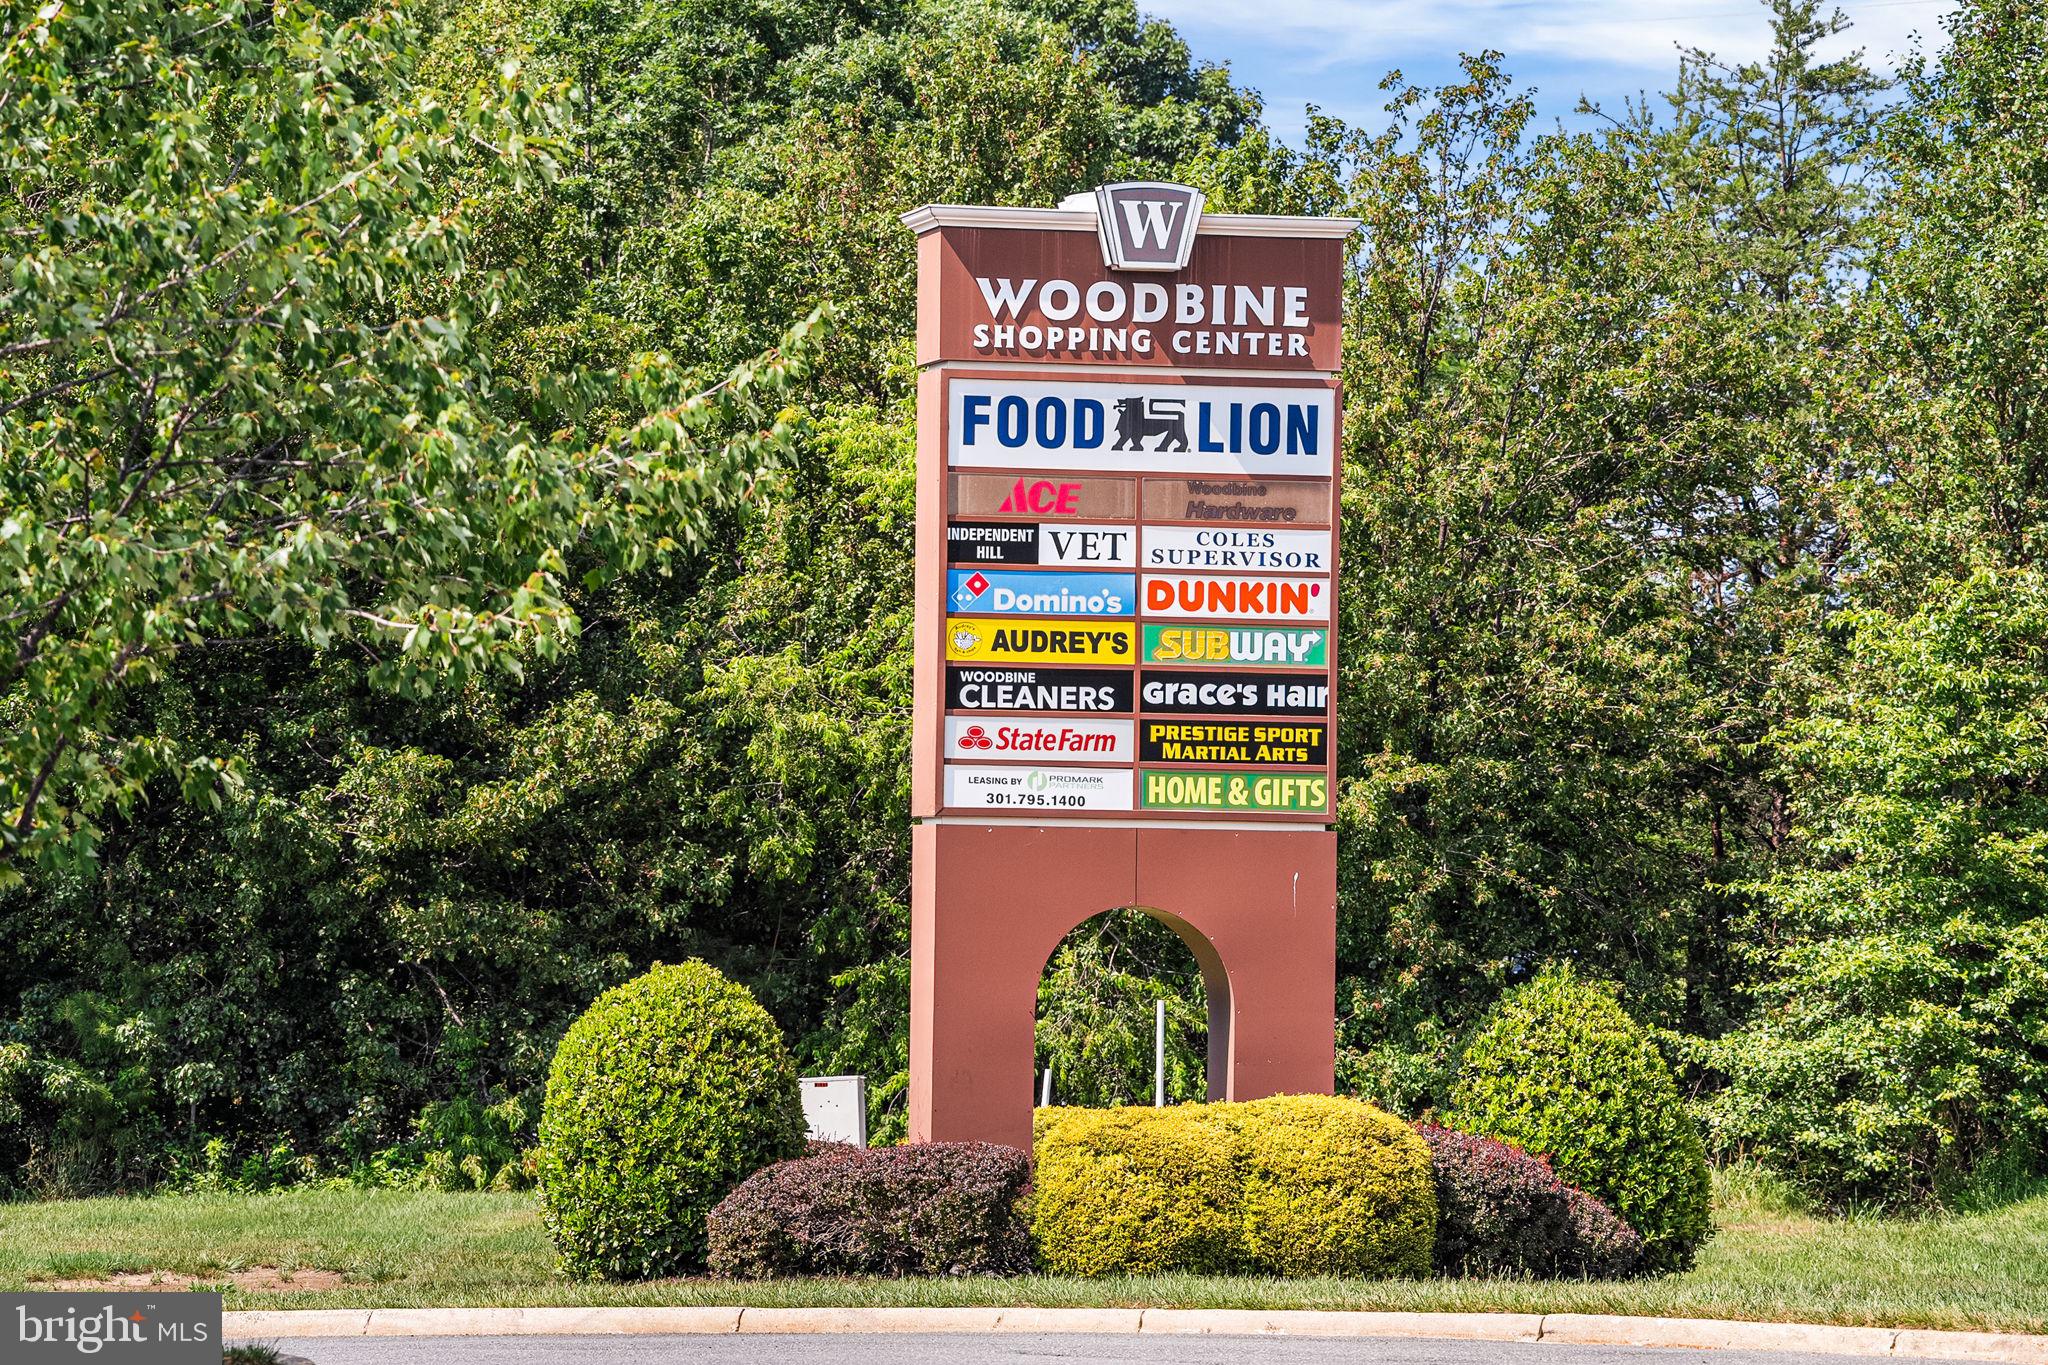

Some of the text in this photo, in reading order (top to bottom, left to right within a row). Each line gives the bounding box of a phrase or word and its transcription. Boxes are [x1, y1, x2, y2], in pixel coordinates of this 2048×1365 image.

[1119, 200, 1183, 250] W
[976, 277, 1310, 327] WOODBINE
[972, 324, 1309, 357] SHOPPING CENTER
[962, 394, 1319, 456] FOOD LION
[997, 476, 1083, 514] ACE
[1187, 480, 1267, 497] Woodbine
[1185, 501, 1297, 521] Hardware
[947, 527, 1034, 543] INDEPENDENT
[1048, 531, 1127, 561] VET
[1196, 531, 1275, 547] COLES
[976, 545, 1004, 559] HILL
[1151, 548, 1321, 568] SUPERVISOR
[993, 588, 1122, 613] Domino's
[1147, 579, 1320, 614] DUNKIN'
[990, 629, 1129, 655] AUDREY'S
[1153, 629, 1322, 663] SUBWAY
[960, 671, 1036, 683] WOODBINE
[959, 684, 1115, 710] CLEANERS
[1143, 681, 1328, 707] Grace's Hair
[1150, 725, 1322, 746] PRESTIGE SPORT
[1162, 743, 1308, 762] MARTIAL ARTS
[968, 776, 1022, 785] LEASING BY
[1049, 775, 1103, 783] PROMARK
[1049, 782, 1104, 790] PARTNERS
[986, 793, 1086, 806] 301.795.1400
[1148, 775, 1326, 807] HOME & GIFTS
